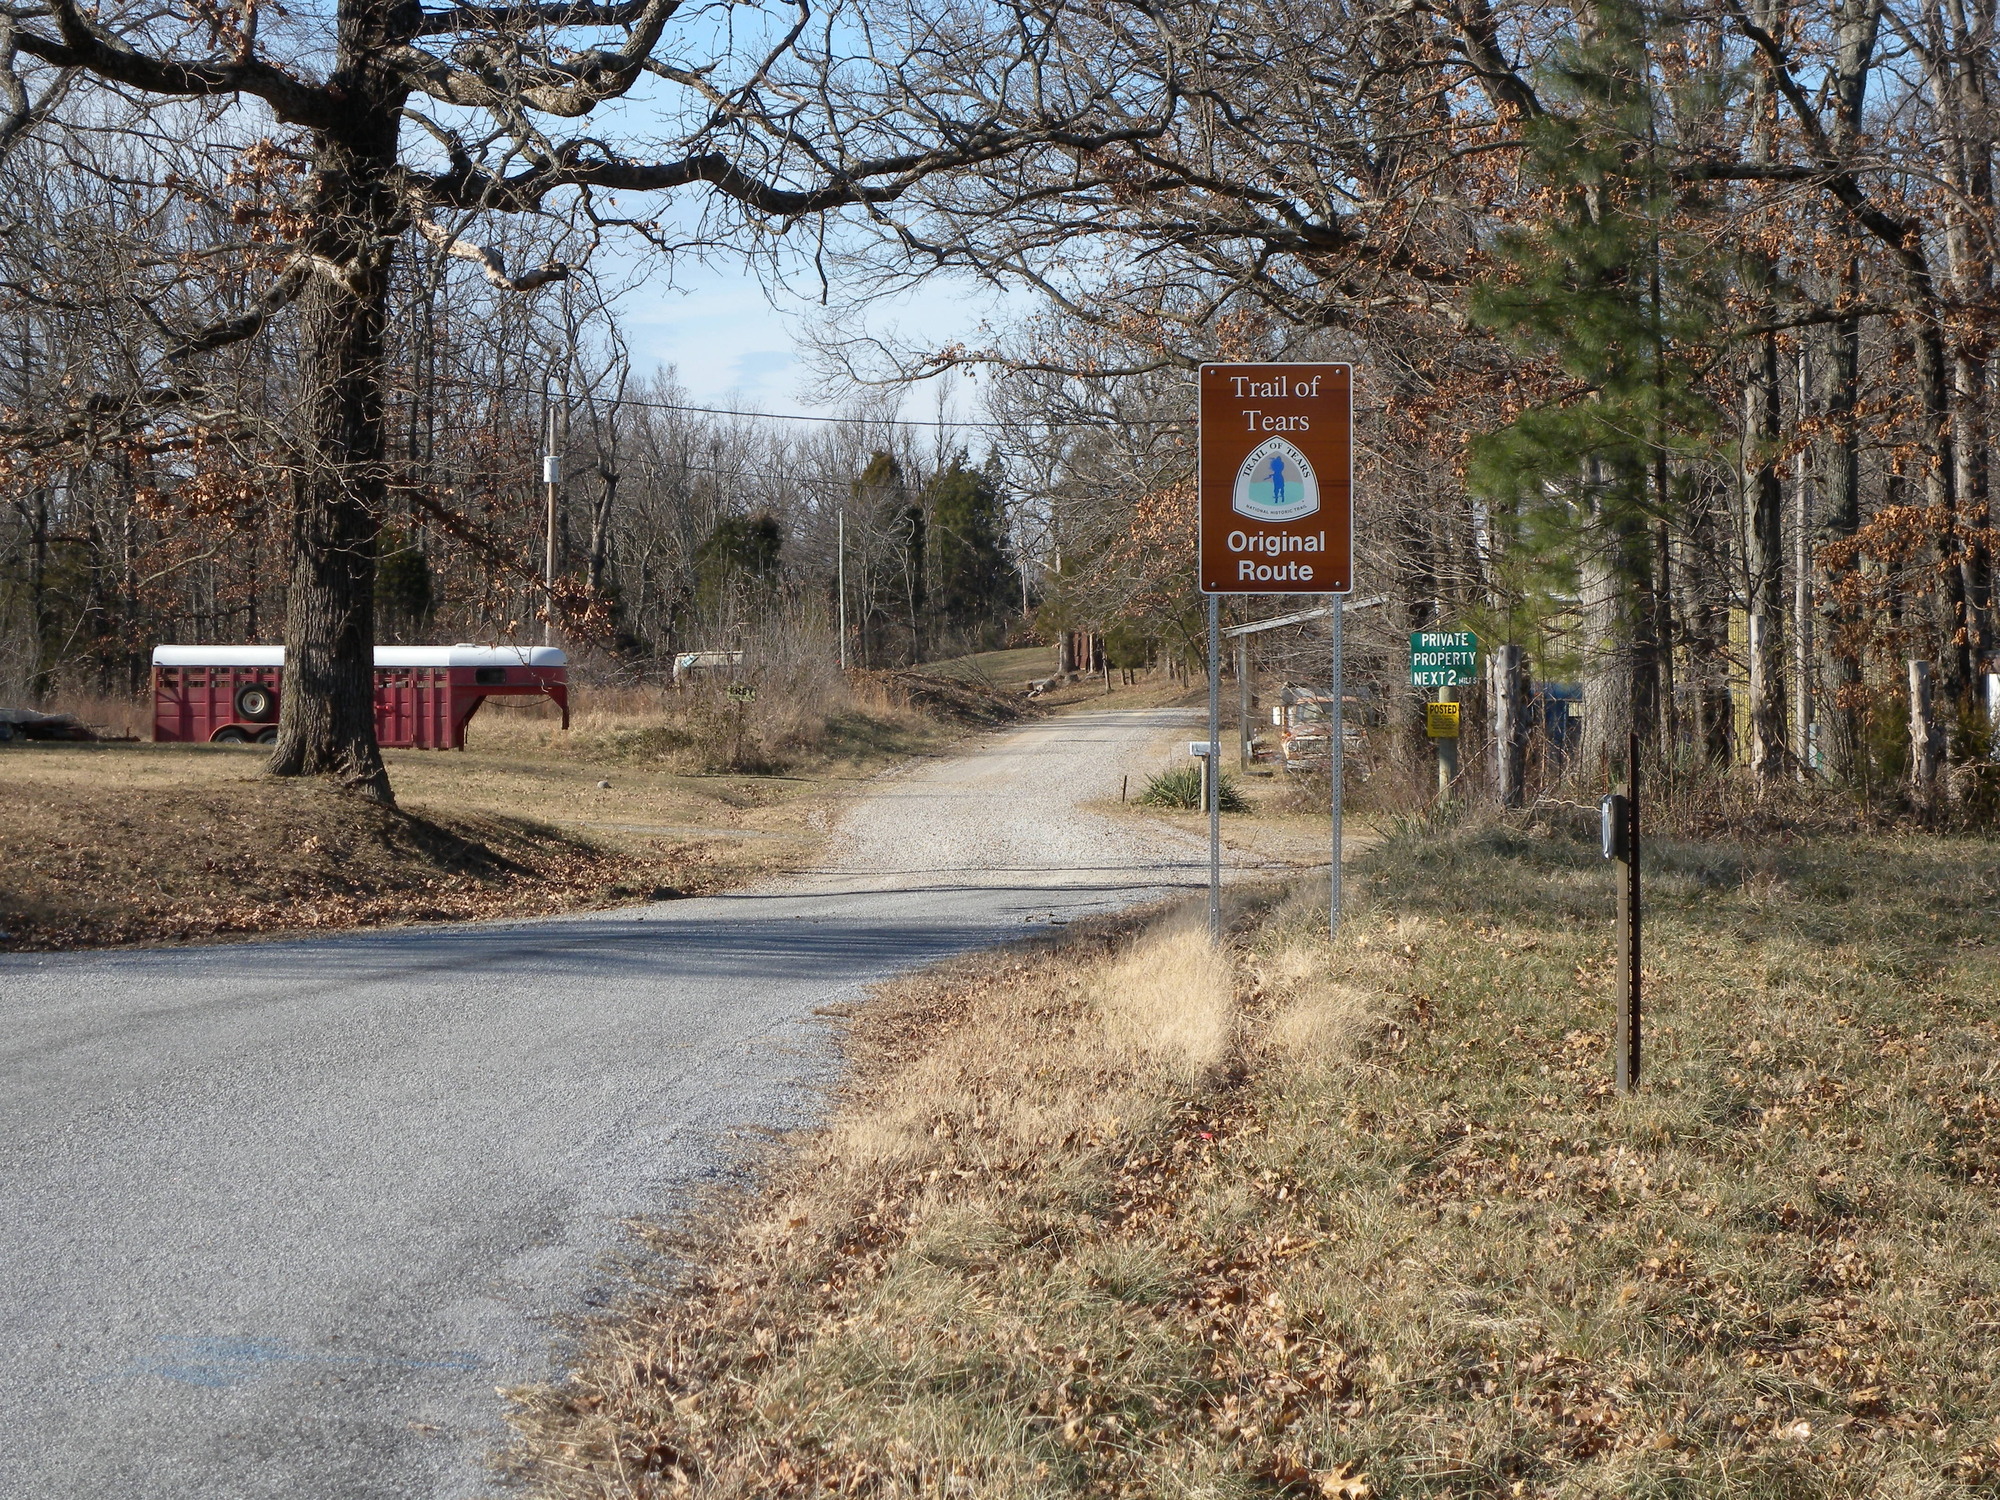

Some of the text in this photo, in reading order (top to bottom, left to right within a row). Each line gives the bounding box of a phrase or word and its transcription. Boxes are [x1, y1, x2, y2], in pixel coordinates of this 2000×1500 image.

[1230, 375, 1322, 398] Trail of
[1242, 410, 1310, 432] Tears
[1242, 449, 1268, 477] TRAIL
[1286, 446, 1311, 478] TEARS
[1246, 504, 1269, 514] NATIONAL
[1294, 504, 1307, 512] TRAIL
[1227, 530, 1325, 557] Original
[1238, 559, 1314, 581] Route
[1421, 633, 1468, 646] PRIVATE
[1413, 652, 1476, 666] PROPERTY
[1413, 671, 1446, 686] NEXT
[1447, 669, 1457, 686] 2
[1429, 704, 1457, 714] POSTED
